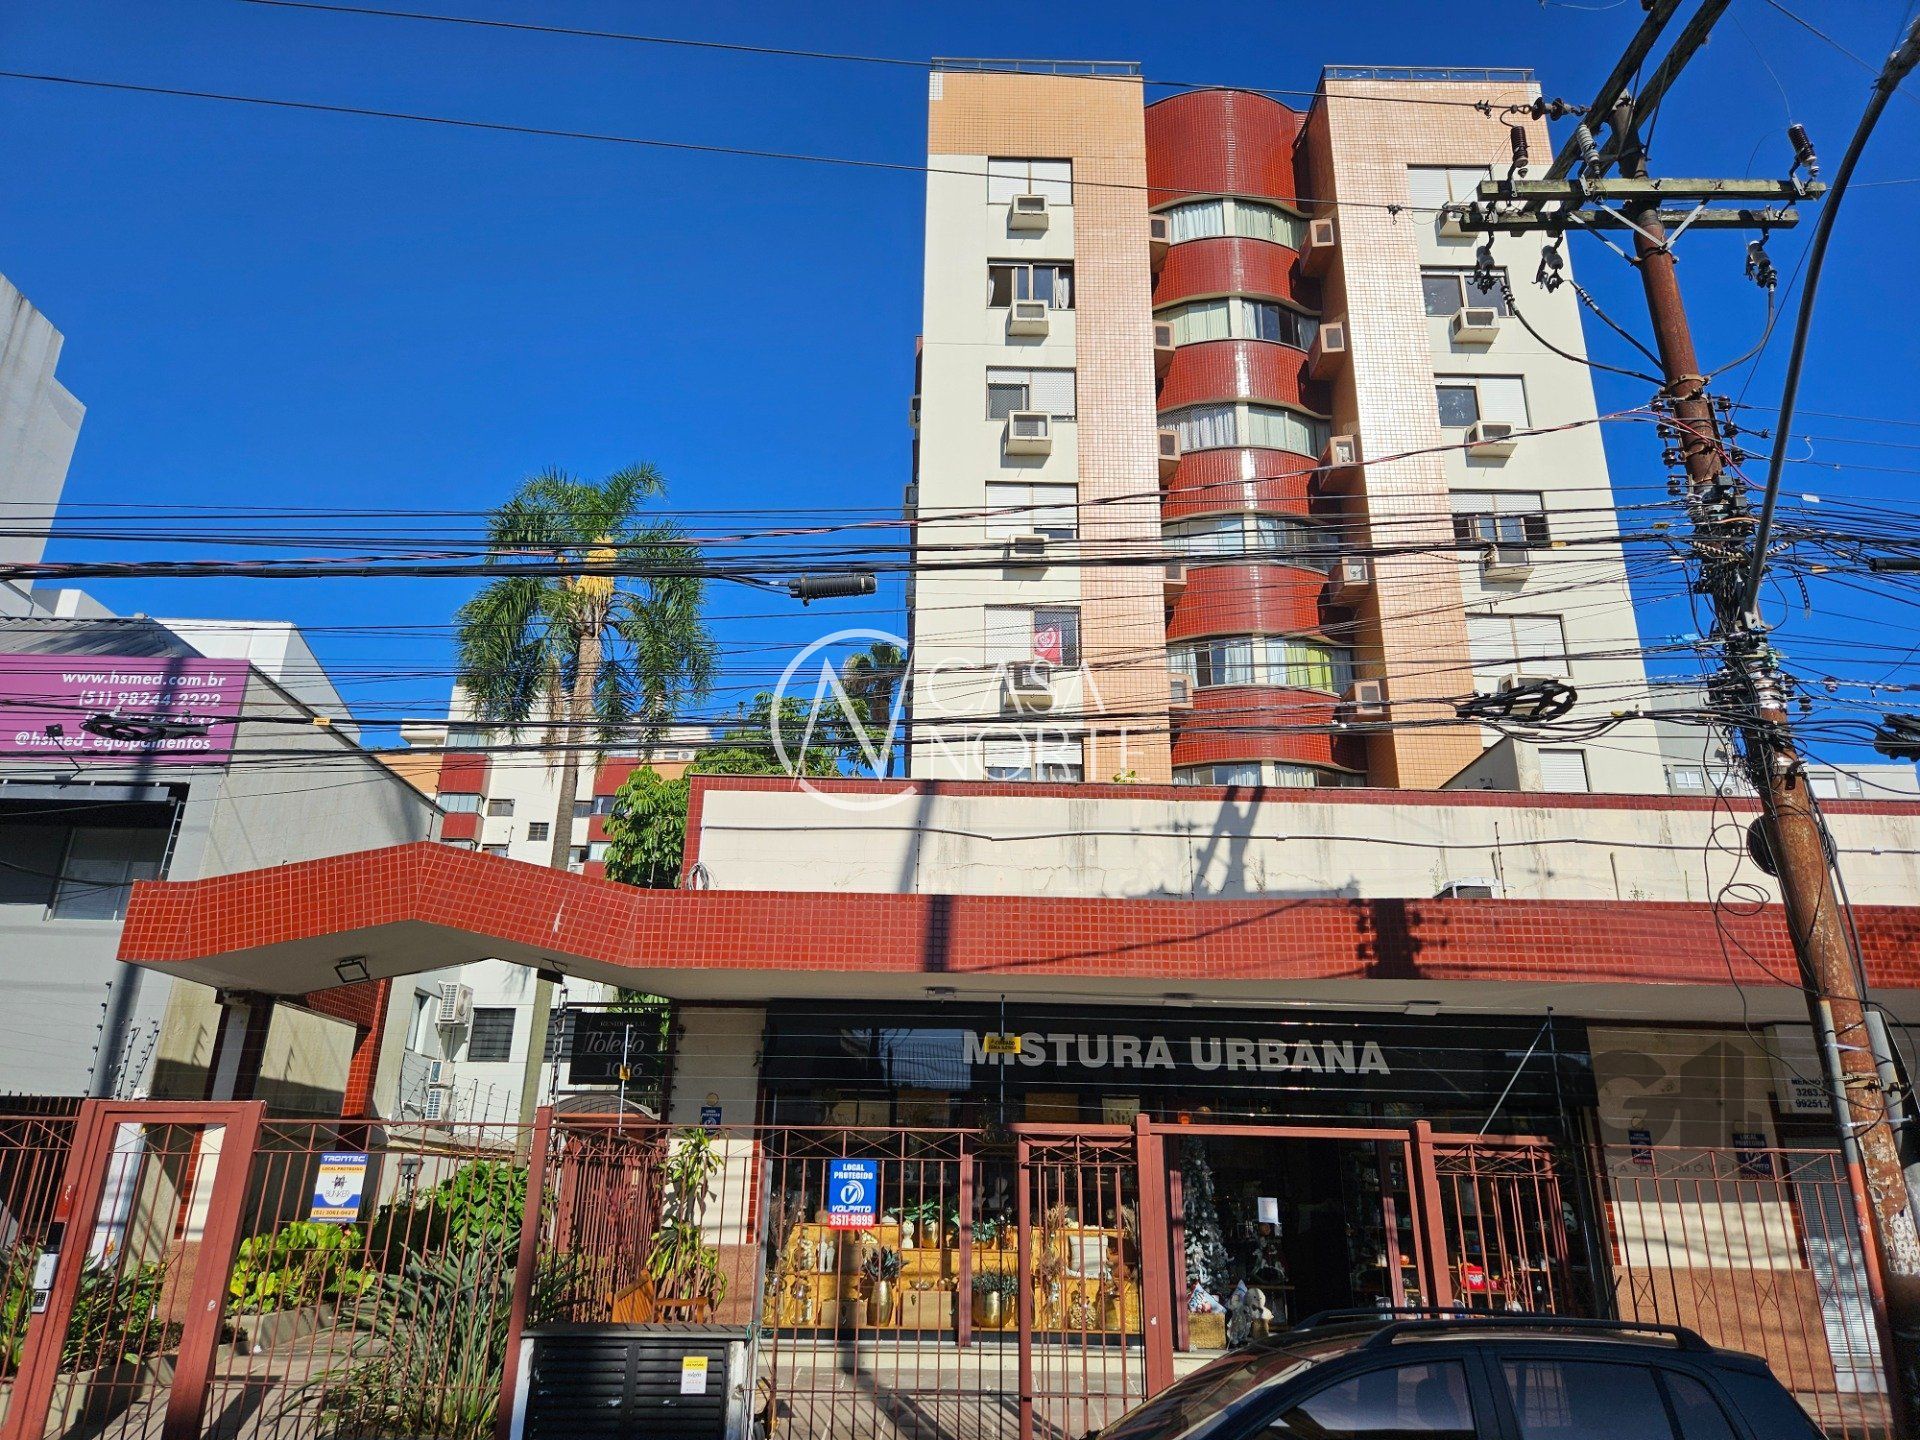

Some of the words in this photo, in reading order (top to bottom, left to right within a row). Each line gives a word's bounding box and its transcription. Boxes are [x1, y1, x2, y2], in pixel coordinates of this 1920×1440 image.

[62, 671, 227, 687] www.hsmed.com.br
[79, 690, 111, 706] (51)
[118, 691, 222, 707] 98244.2222
[584, 1031, 645, 1053] Toledo
[963, 1031, 1176, 1069] MISTURA
[1190, 1035, 1391, 1075] URBANA
[605, 1062, 644, 1077] 106
[843, 1163, 865, 1171] LOCAL
[832, 1205, 871, 1213] VOLPATO
[830, 1214, 873, 1226] 3511-9999
